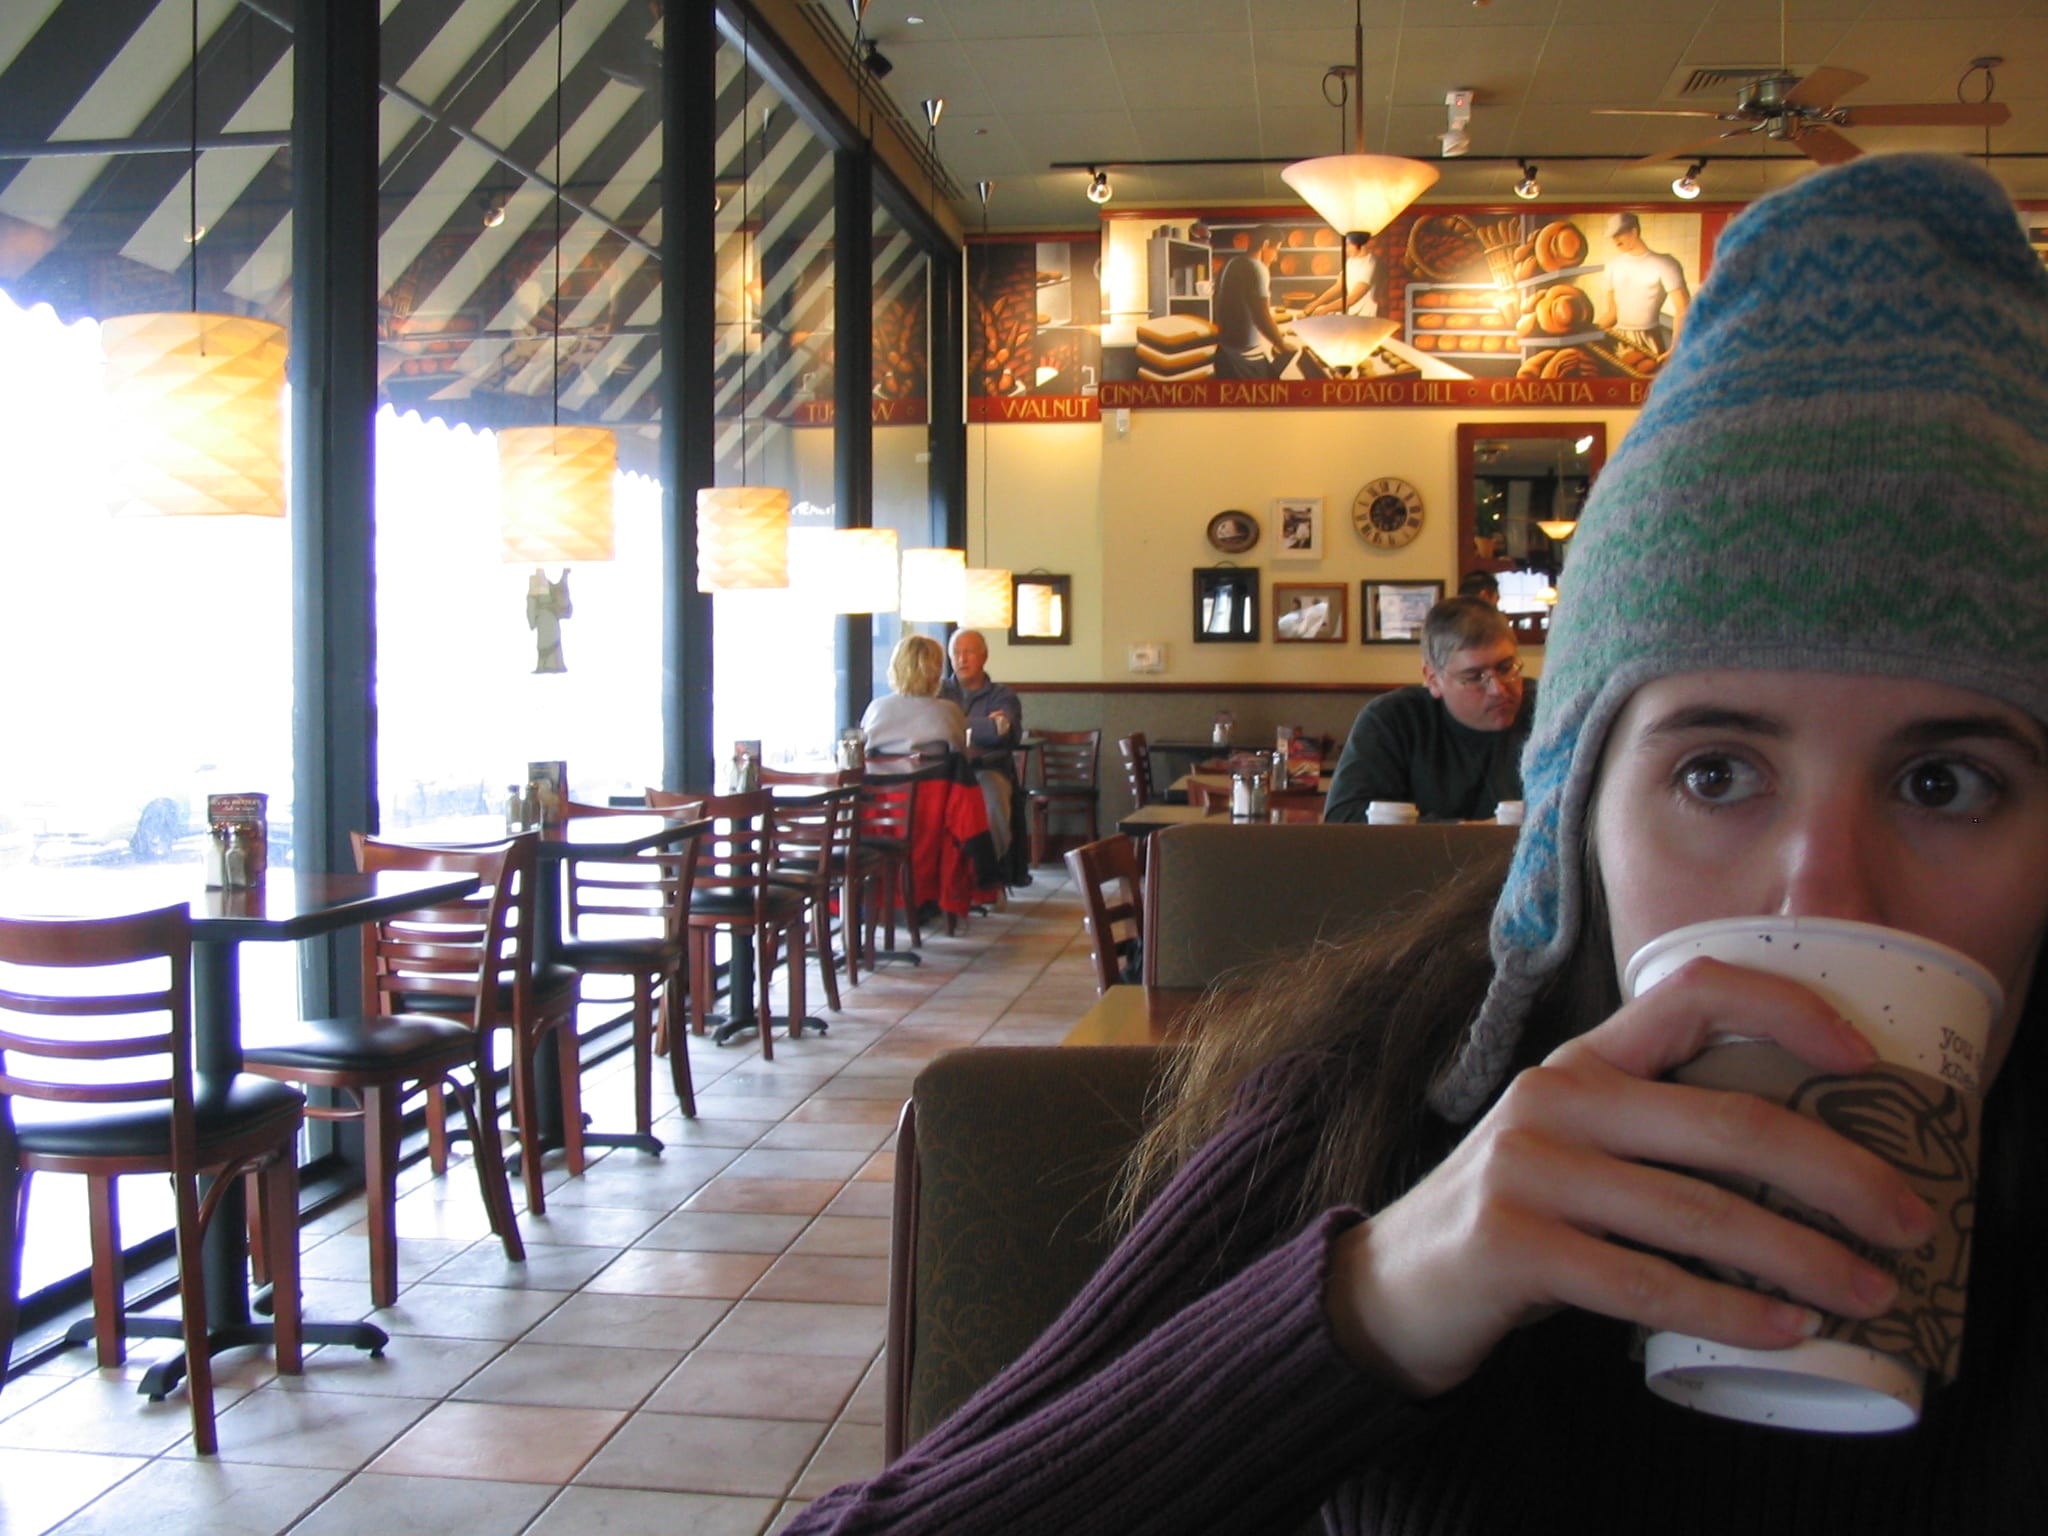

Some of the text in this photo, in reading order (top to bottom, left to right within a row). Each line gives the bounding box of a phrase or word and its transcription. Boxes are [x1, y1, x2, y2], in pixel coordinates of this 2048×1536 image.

[1100, 383, 1289, 404] CINNAMON RAISIN
[1322, 382, 1457, 404] POTATO DILL
[1490, 382, 1593, 403] CIABATTA
[1001, 399, 1090, 419] WALNUT
[1939, 1026, 1973, 1062] you
